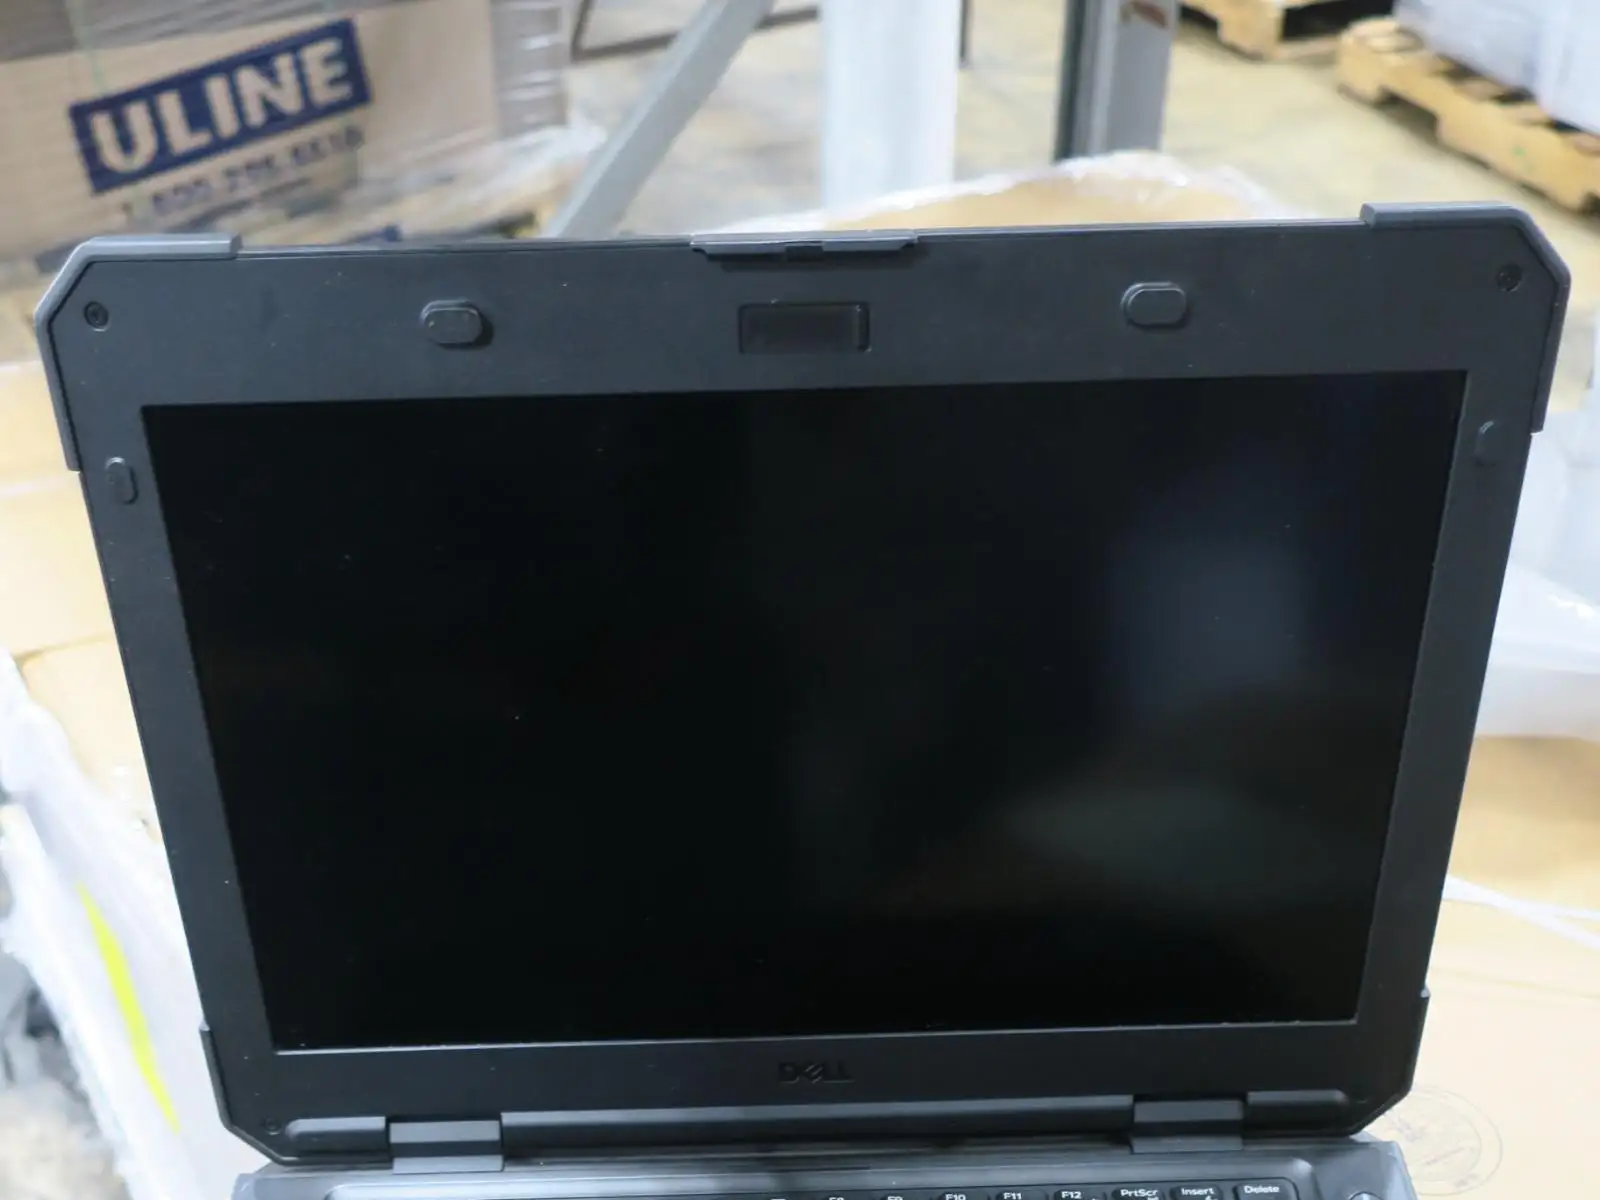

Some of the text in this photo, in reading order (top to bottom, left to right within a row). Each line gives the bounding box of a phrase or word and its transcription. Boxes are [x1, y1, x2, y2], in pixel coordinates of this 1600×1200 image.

[90, 37, 353, 173] ULINE
[778, 1062, 855, 1084] DELL
[1121, 1189, 1158, 1198] PrtScr
[1181, 1187, 1214, 1196] Insert
